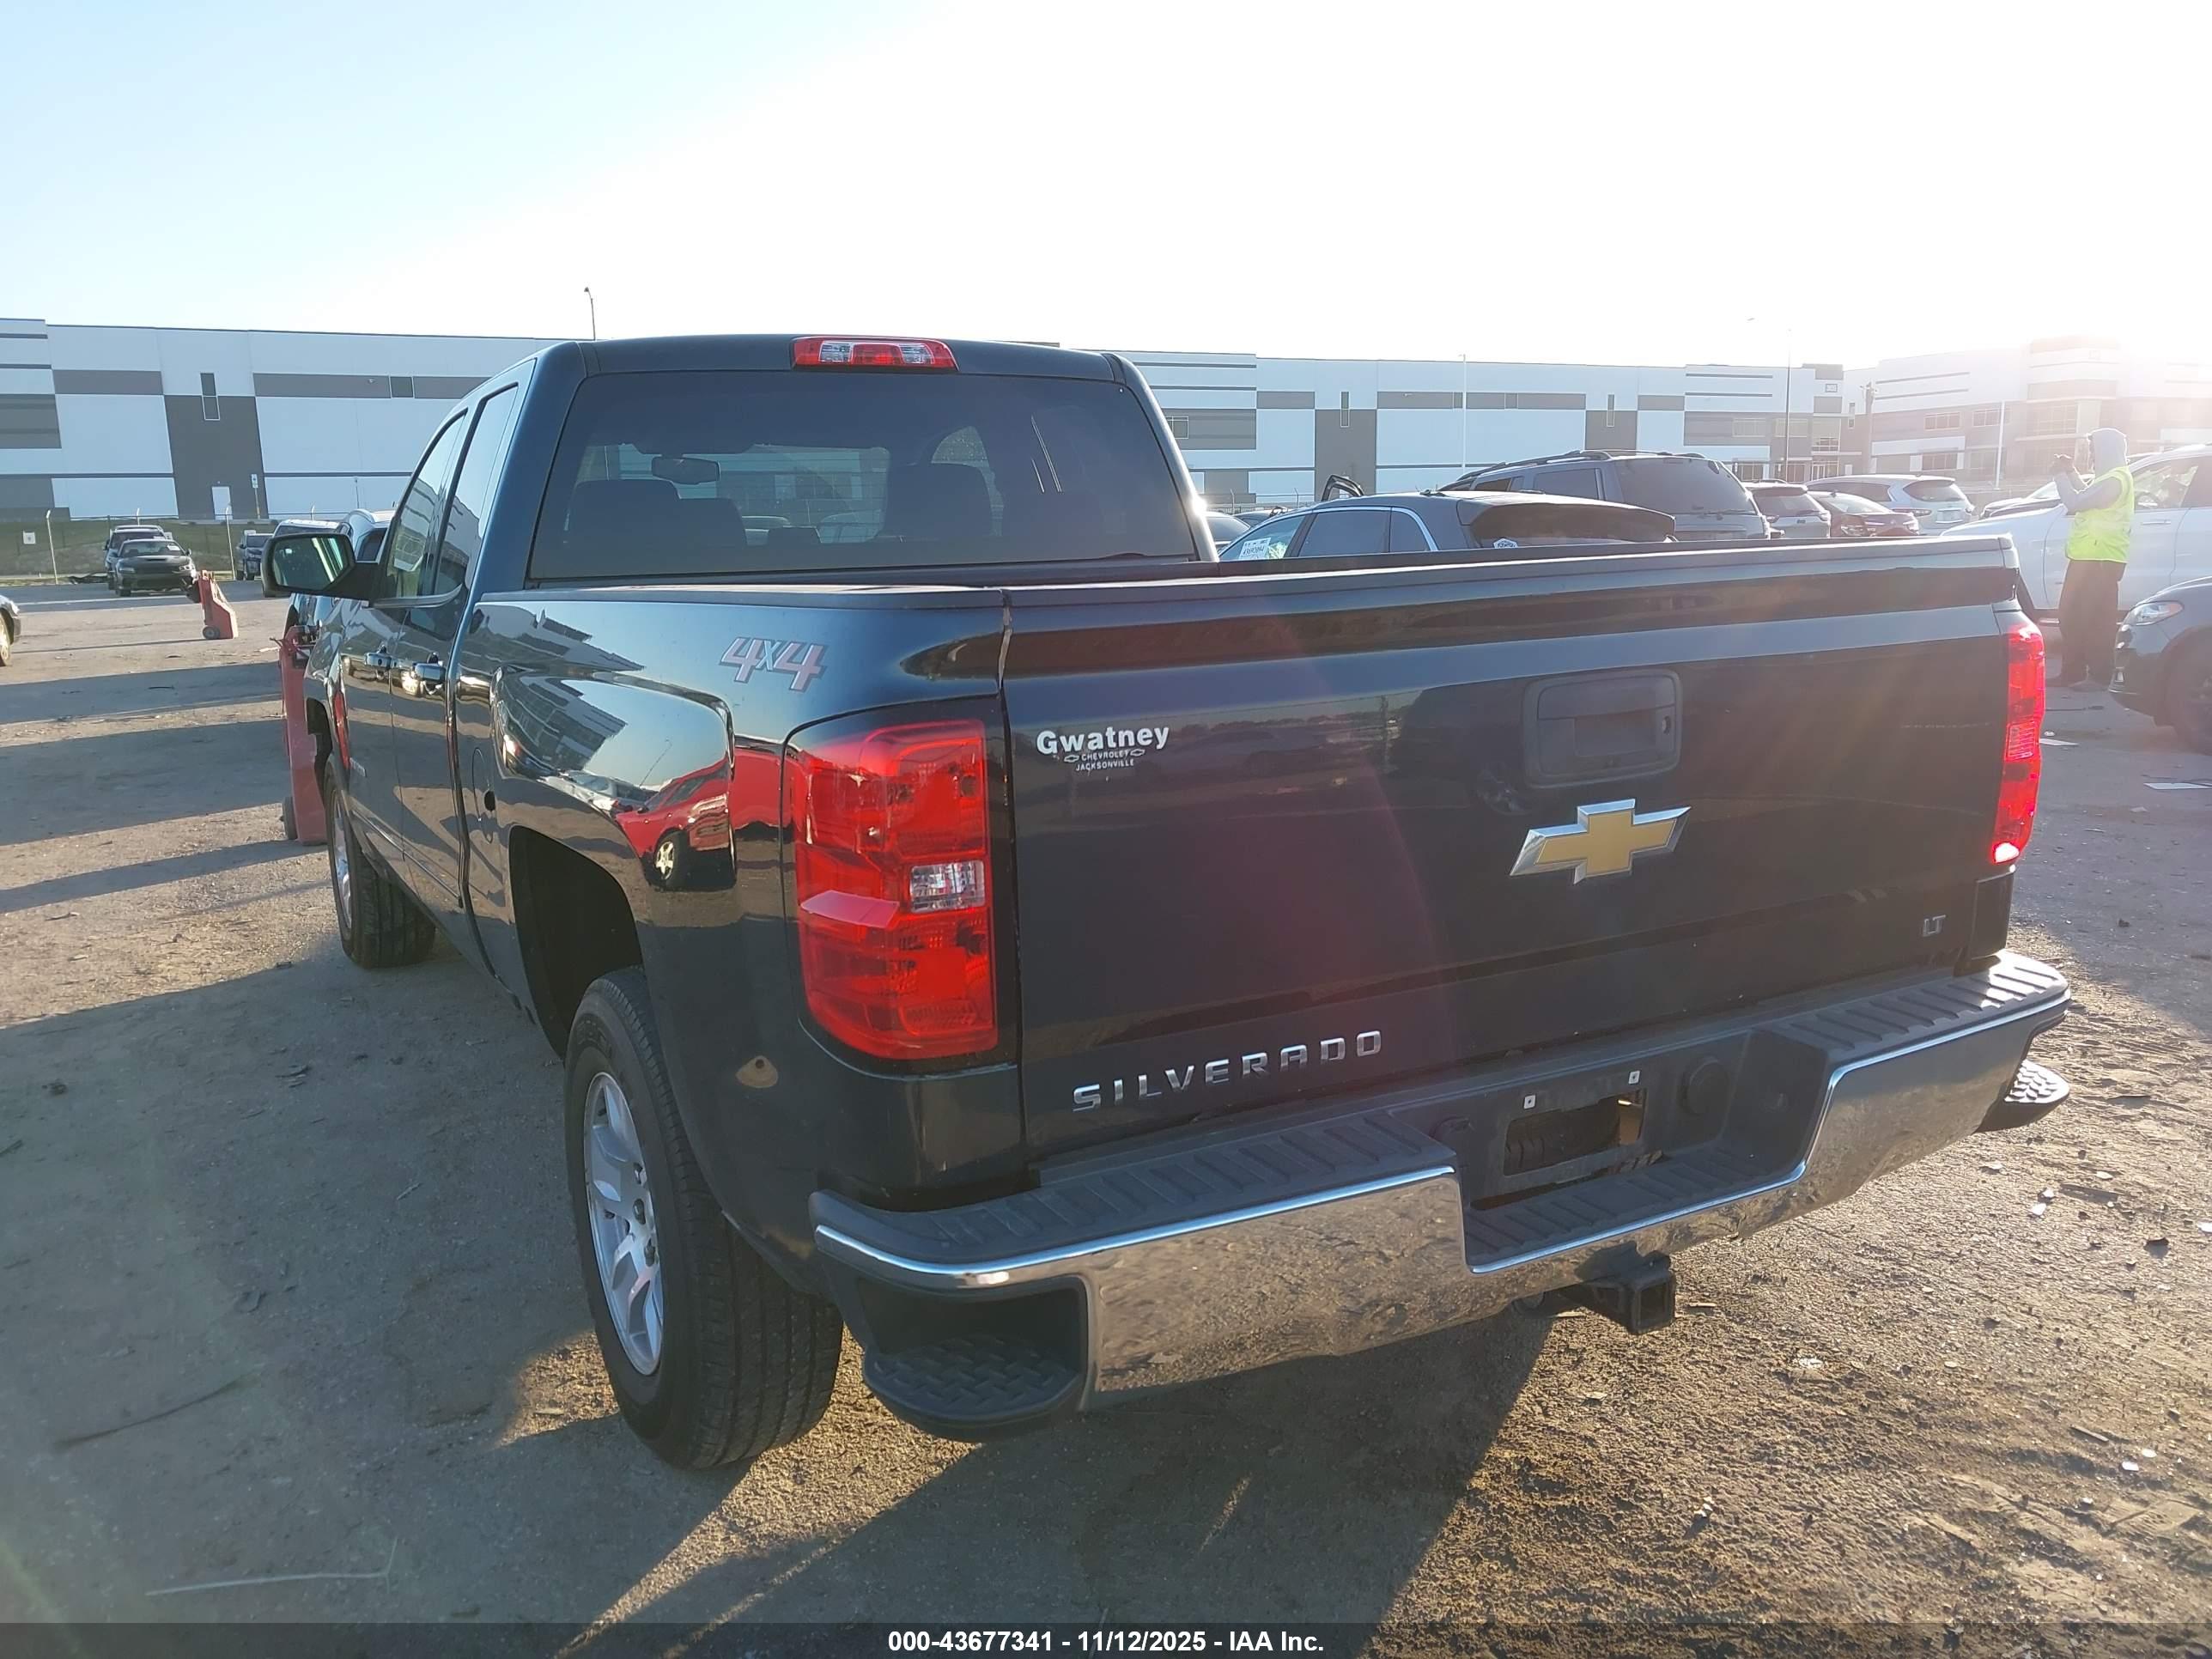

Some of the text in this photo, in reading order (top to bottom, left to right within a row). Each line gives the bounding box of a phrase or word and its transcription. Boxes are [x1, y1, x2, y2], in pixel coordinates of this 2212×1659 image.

[1036, 726, 1170, 756] Gwatney
[1075, 758, 1134, 772] JACKSONVILLE
[1080, 749, 1130, 763] CHEVROLET
[1922, 914, 1947, 937] LT
[1073, 1030, 1382, 1112] SILVERADO
